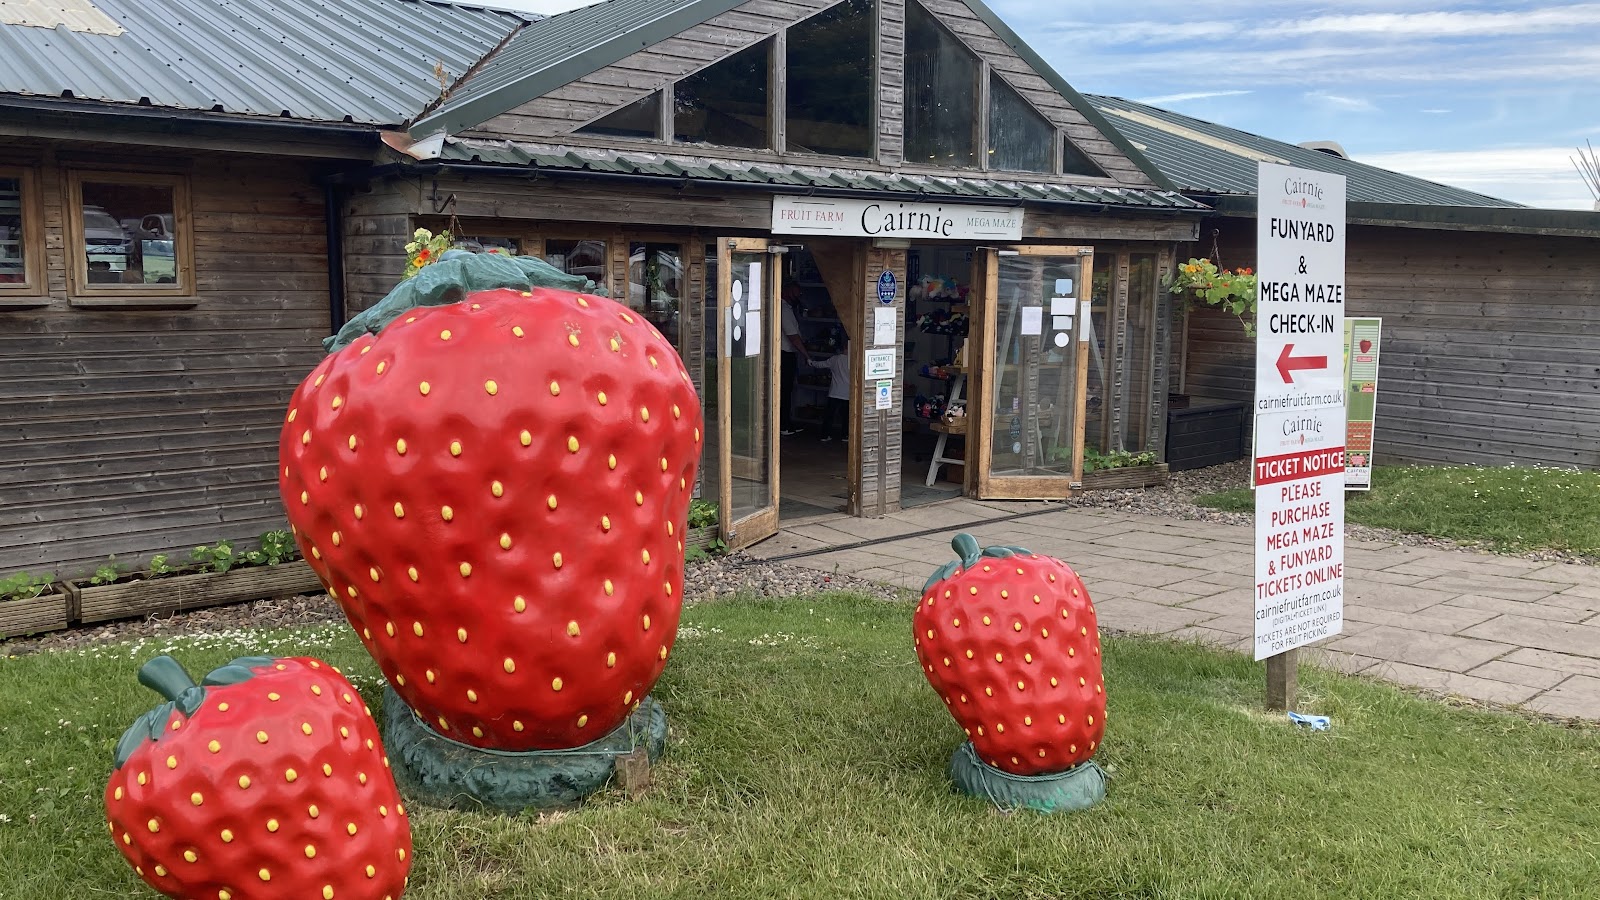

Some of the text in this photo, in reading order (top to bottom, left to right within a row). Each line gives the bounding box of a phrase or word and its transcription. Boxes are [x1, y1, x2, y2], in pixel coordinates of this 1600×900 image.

[1285, 177, 1323, 200] Cairnie
[780, 209, 844, 223] FRUIT FARM
[861, 203, 954, 237] Cairnie
[966, 217, 1017, 229] MEGA MAZE
[1270, 218, 1334, 243] FUNYARD
[1298, 255, 1307, 274] &
[1261, 282, 1342, 303] MEGA MAZE
[1269, 313, 1334, 334] CHECK-IN
[1258, 389, 1342, 409] cairniefruitfarm.co.uk
[1282, 415, 1322, 436] Cairnie
[1257, 451, 1344, 479] TICKET NOTICE
[1281, 481, 1321, 503] PLEASE
[1271, 502, 1330, 527] PURCHASE
[1267, 522, 1334, 551] MEGA MAZE
[1268, 545, 1333, 576] & FUNYARD
[1257, 563, 1342, 599] TICKETS ONLINE
[1255, 584, 1342, 620] cairniefruitfarm.co.uk
[1257, 611, 1341, 644] TICKETS ARE NOT REQUIRED
[1271, 626, 1327, 651] FOR FRUIT PICKING
